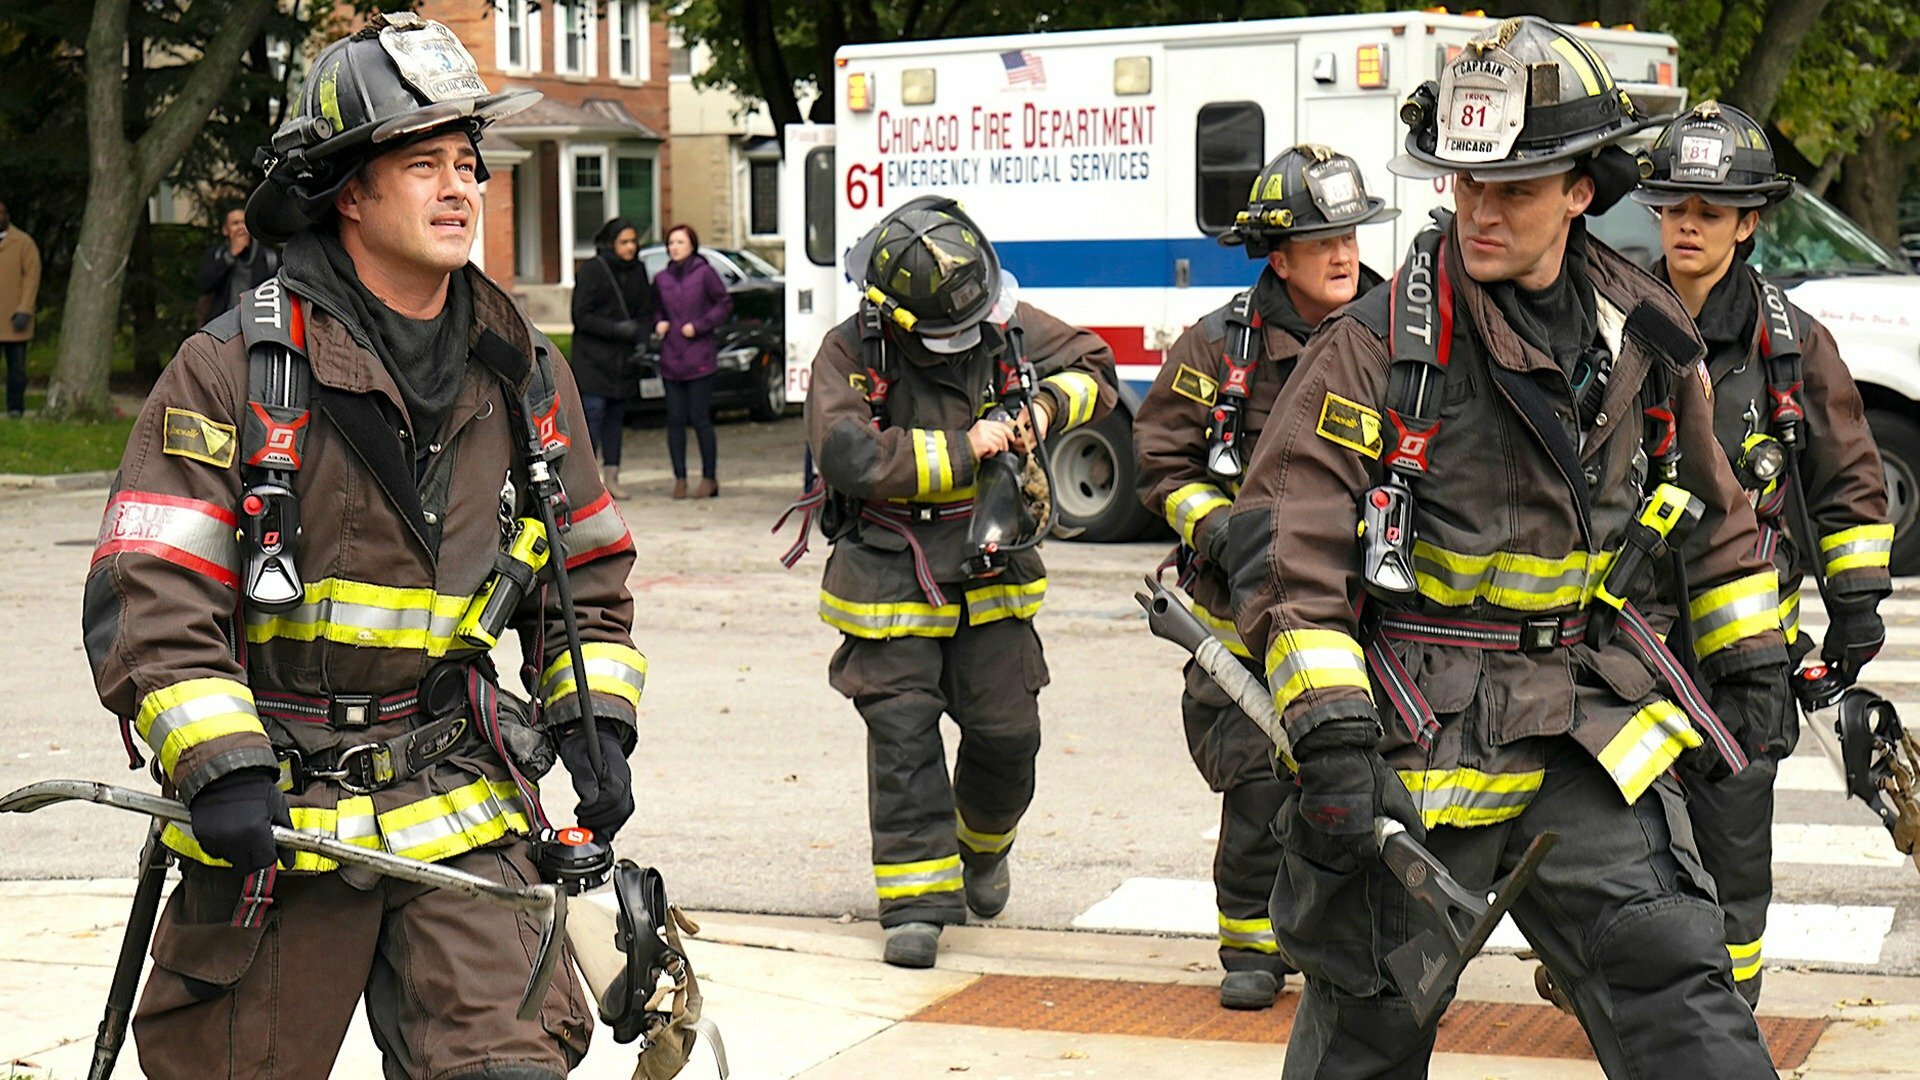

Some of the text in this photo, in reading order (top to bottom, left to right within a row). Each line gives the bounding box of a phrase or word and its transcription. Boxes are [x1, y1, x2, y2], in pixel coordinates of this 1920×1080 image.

[1460, 60, 1505, 77] CAPTAIN
[1464, 93, 1491, 102] TRUCK
[1461, 104, 1487, 127] 81
[879, 102, 1156, 154] CHICAGO FIRE DEPARTMENT
[1450, 140, 1493, 153] CHICAGO
[1690, 145, 1709, 160] 81
[888, 152, 1150, 187] EMERGENCY MEDICAL SERVICES
[846, 162, 884, 209] 61
[1406, 251, 1433, 347] SCOTT
